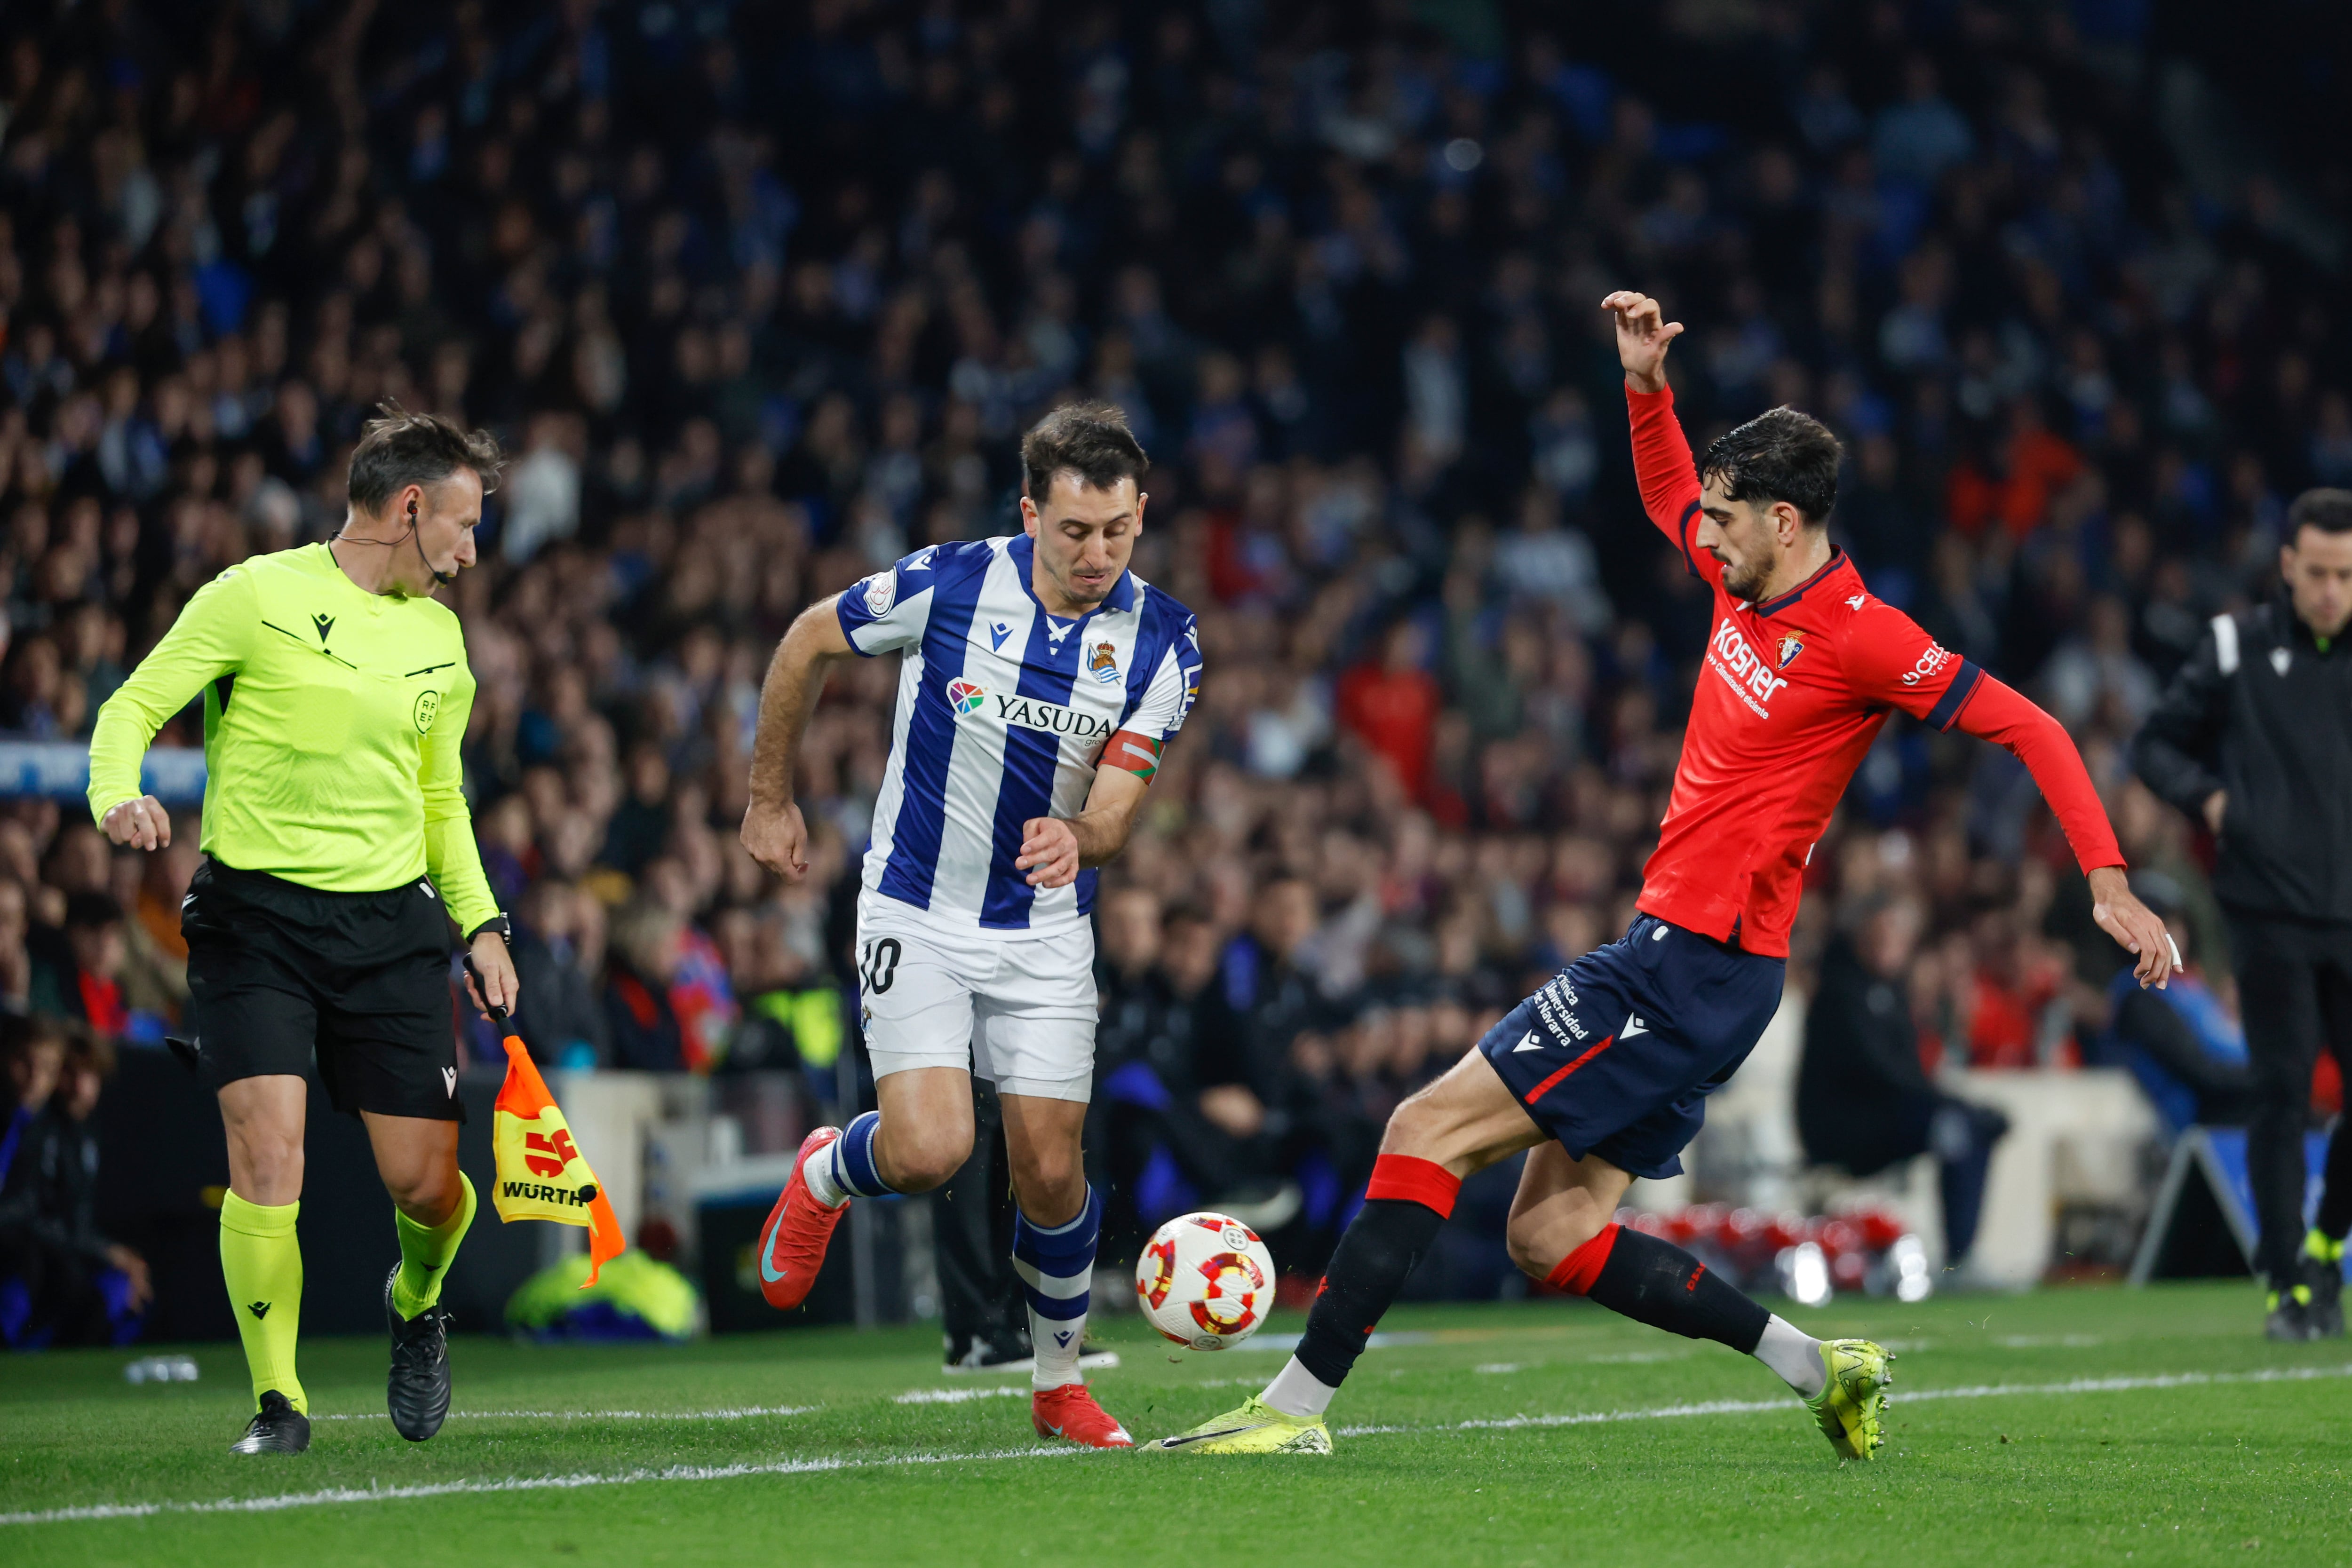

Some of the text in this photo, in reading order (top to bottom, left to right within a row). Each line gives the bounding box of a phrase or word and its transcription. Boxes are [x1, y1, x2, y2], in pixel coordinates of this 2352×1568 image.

[1715, 662, 1769, 720] Climatización eficiente
[995, 694, 1111, 737] YASUDA
[1537, 1000, 1571, 1047] Navarra
[1545, 982, 1589, 1040] Universidad
[503, 1182, 583, 1208] WÜRTH
